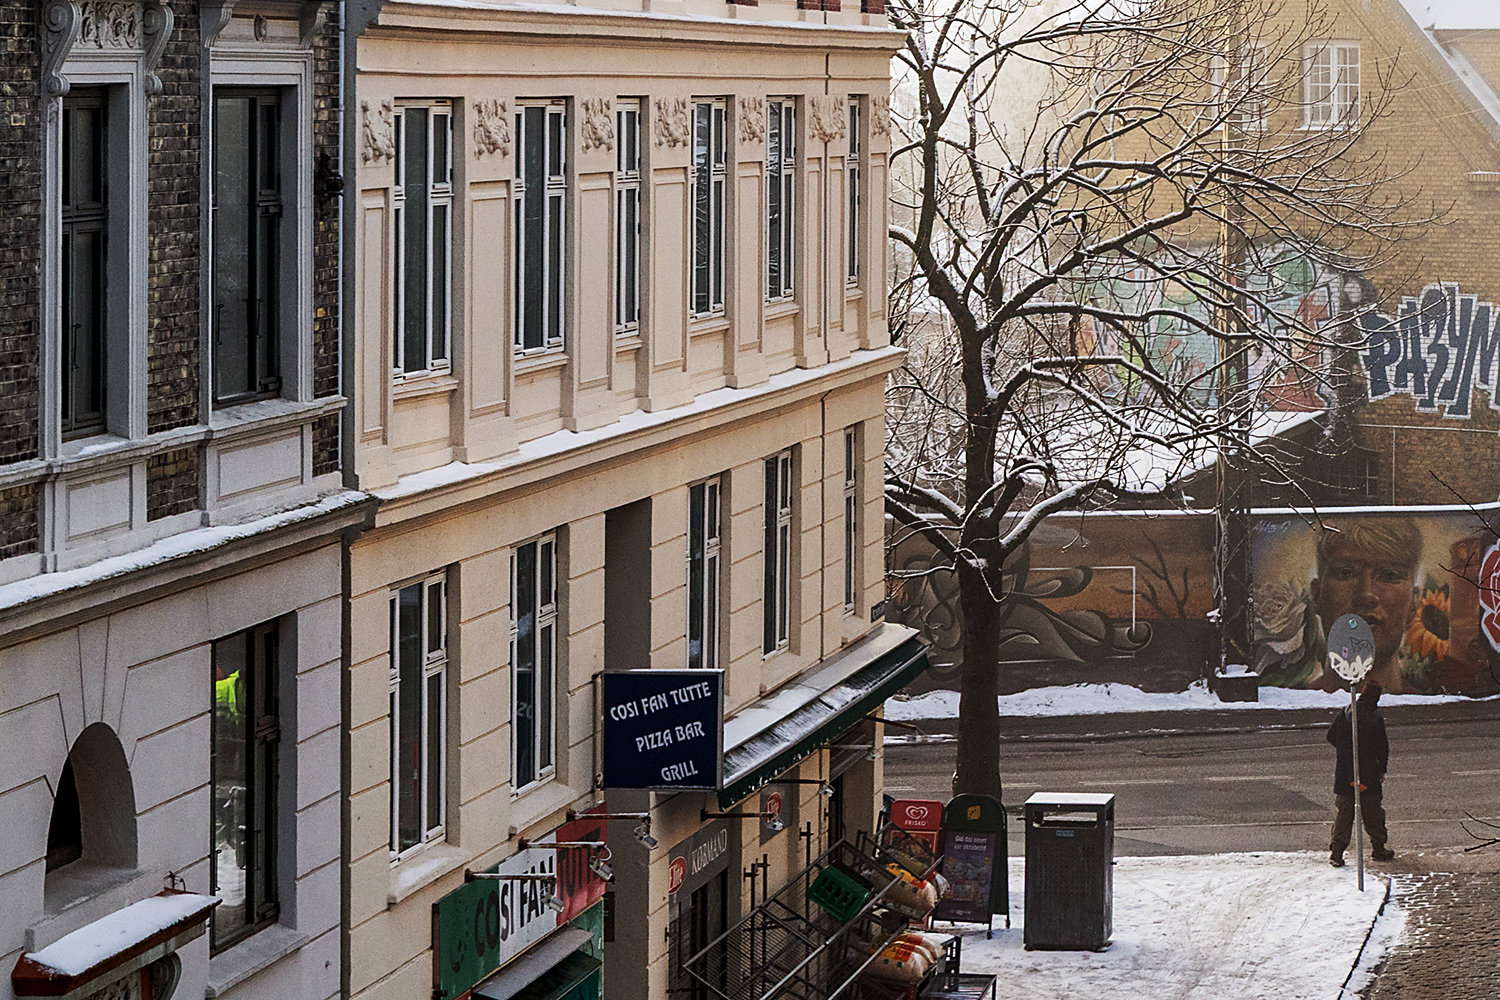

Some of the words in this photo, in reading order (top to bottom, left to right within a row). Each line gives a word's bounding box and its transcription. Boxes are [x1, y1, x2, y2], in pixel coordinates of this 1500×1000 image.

[610, 701, 639, 721] COSI
[641, 693, 668, 715] FAN
[669, 681, 712, 705] TUTTE
[635, 729, 673, 752] PIZZA
[675, 721, 705, 741] BAR
[661, 760, 699, 781] GRILL
[904, 819, 927, 827] FRISKO
[474, 880, 515, 957] COSI
[519, 855, 555, 928] FAN
